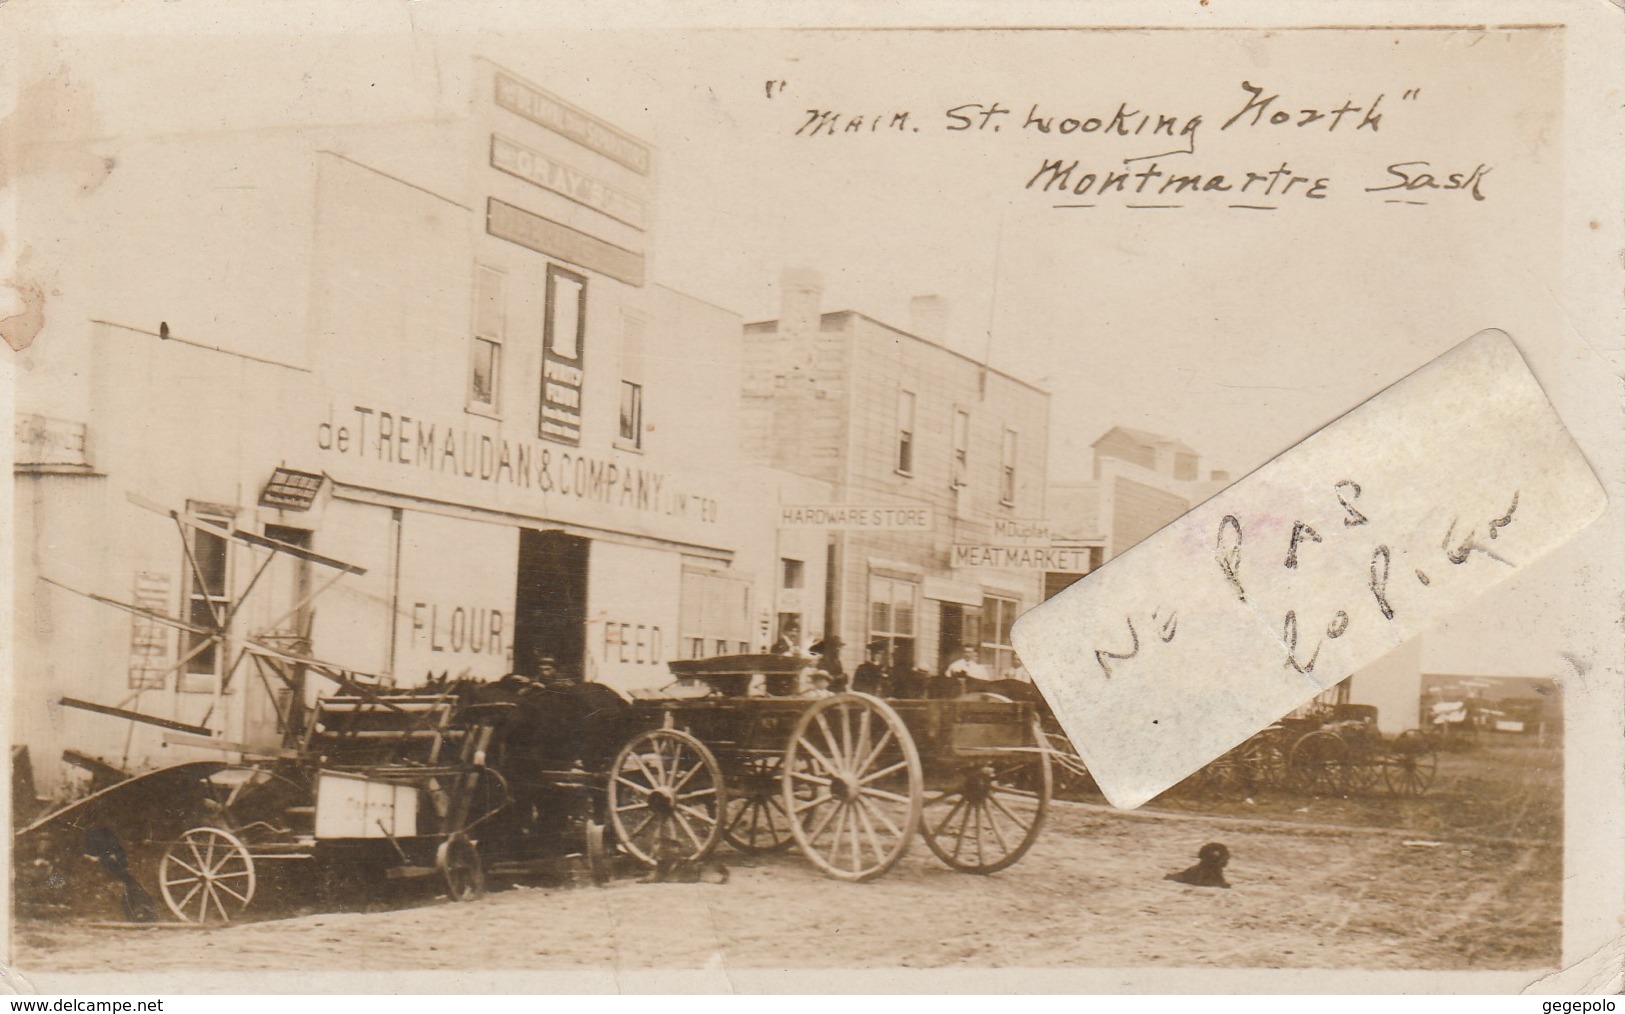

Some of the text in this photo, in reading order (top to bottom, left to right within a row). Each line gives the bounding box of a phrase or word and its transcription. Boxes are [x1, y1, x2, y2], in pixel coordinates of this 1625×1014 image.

[946, 102, 1009, 132] St.
[318, 402, 349, 453] de
[354, 405, 531, 488] TREMAUDAN
[538, 449, 553, 492] &
[559, 453, 664, 512] COMPANY
[782, 508, 928, 527] HARDWARE STORE
[954, 547, 1085, 570] MEAT MARKET
[411, 602, 504, 656] FLOUR
[604, 620, 663, 666] FEED
